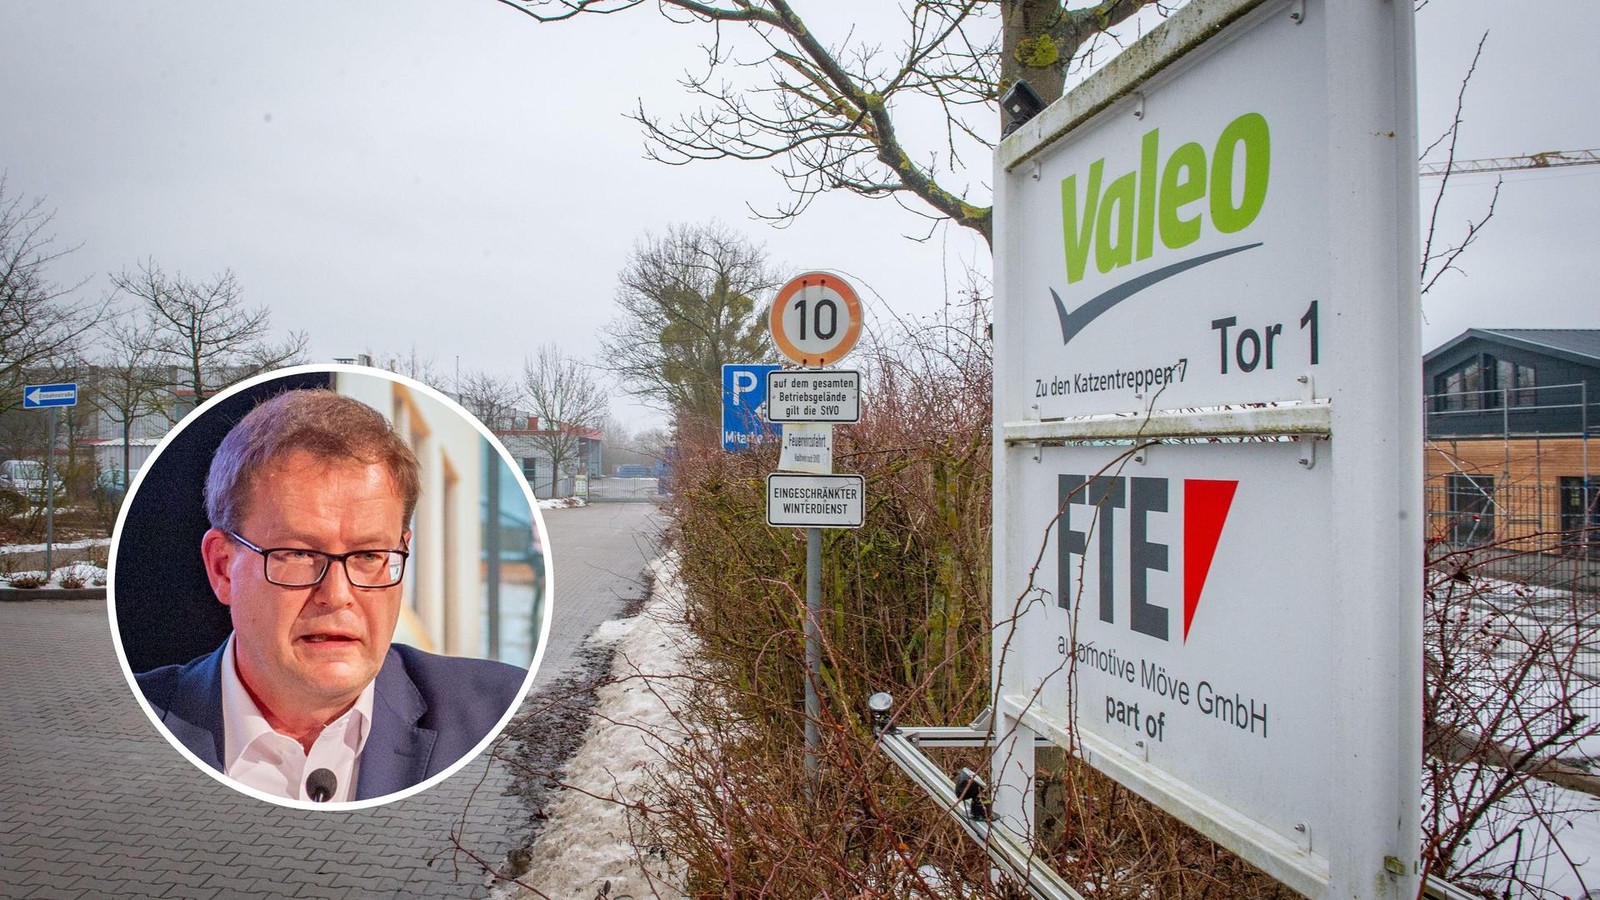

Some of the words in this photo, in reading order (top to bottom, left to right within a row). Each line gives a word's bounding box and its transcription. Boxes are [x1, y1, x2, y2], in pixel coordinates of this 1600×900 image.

[1061, 112, 1270, 284] Valeo
[794, 299, 837, 340] 10
[1211, 316, 1282, 374] Tor
[1300, 300, 1319, 365] 1
[732, 371, 758, 405] P
[773, 378, 787, 388] auf
[791, 378, 809, 388] dem
[812, 378, 854, 390] gesamten
[779, 392, 847, 404] Betriebsgelände
[1035, 379, 1047, 398] Zu
[1050, 375, 1070, 396] den
[1074, 365, 1173, 394] Katzentreppen
[1178, 358, 1188, 383] 7
[786, 405, 800, 417] gilt
[803, 405, 817, 415] die
[820, 405, 840, 416] StVO
[774, 486, 857, 500] EINGESCHRÄNKTER
[783, 503, 848, 515] WINTERDIENST
[1058, 474, 1169, 642] FTE
[1057, 635, 1135, 683] auomotive
[1141, 659, 1190, 705] Möve
[1197, 681, 1267, 738] GmbH
[1105, 695, 1140, 732] part
[1146, 712, 1165, 742] of
